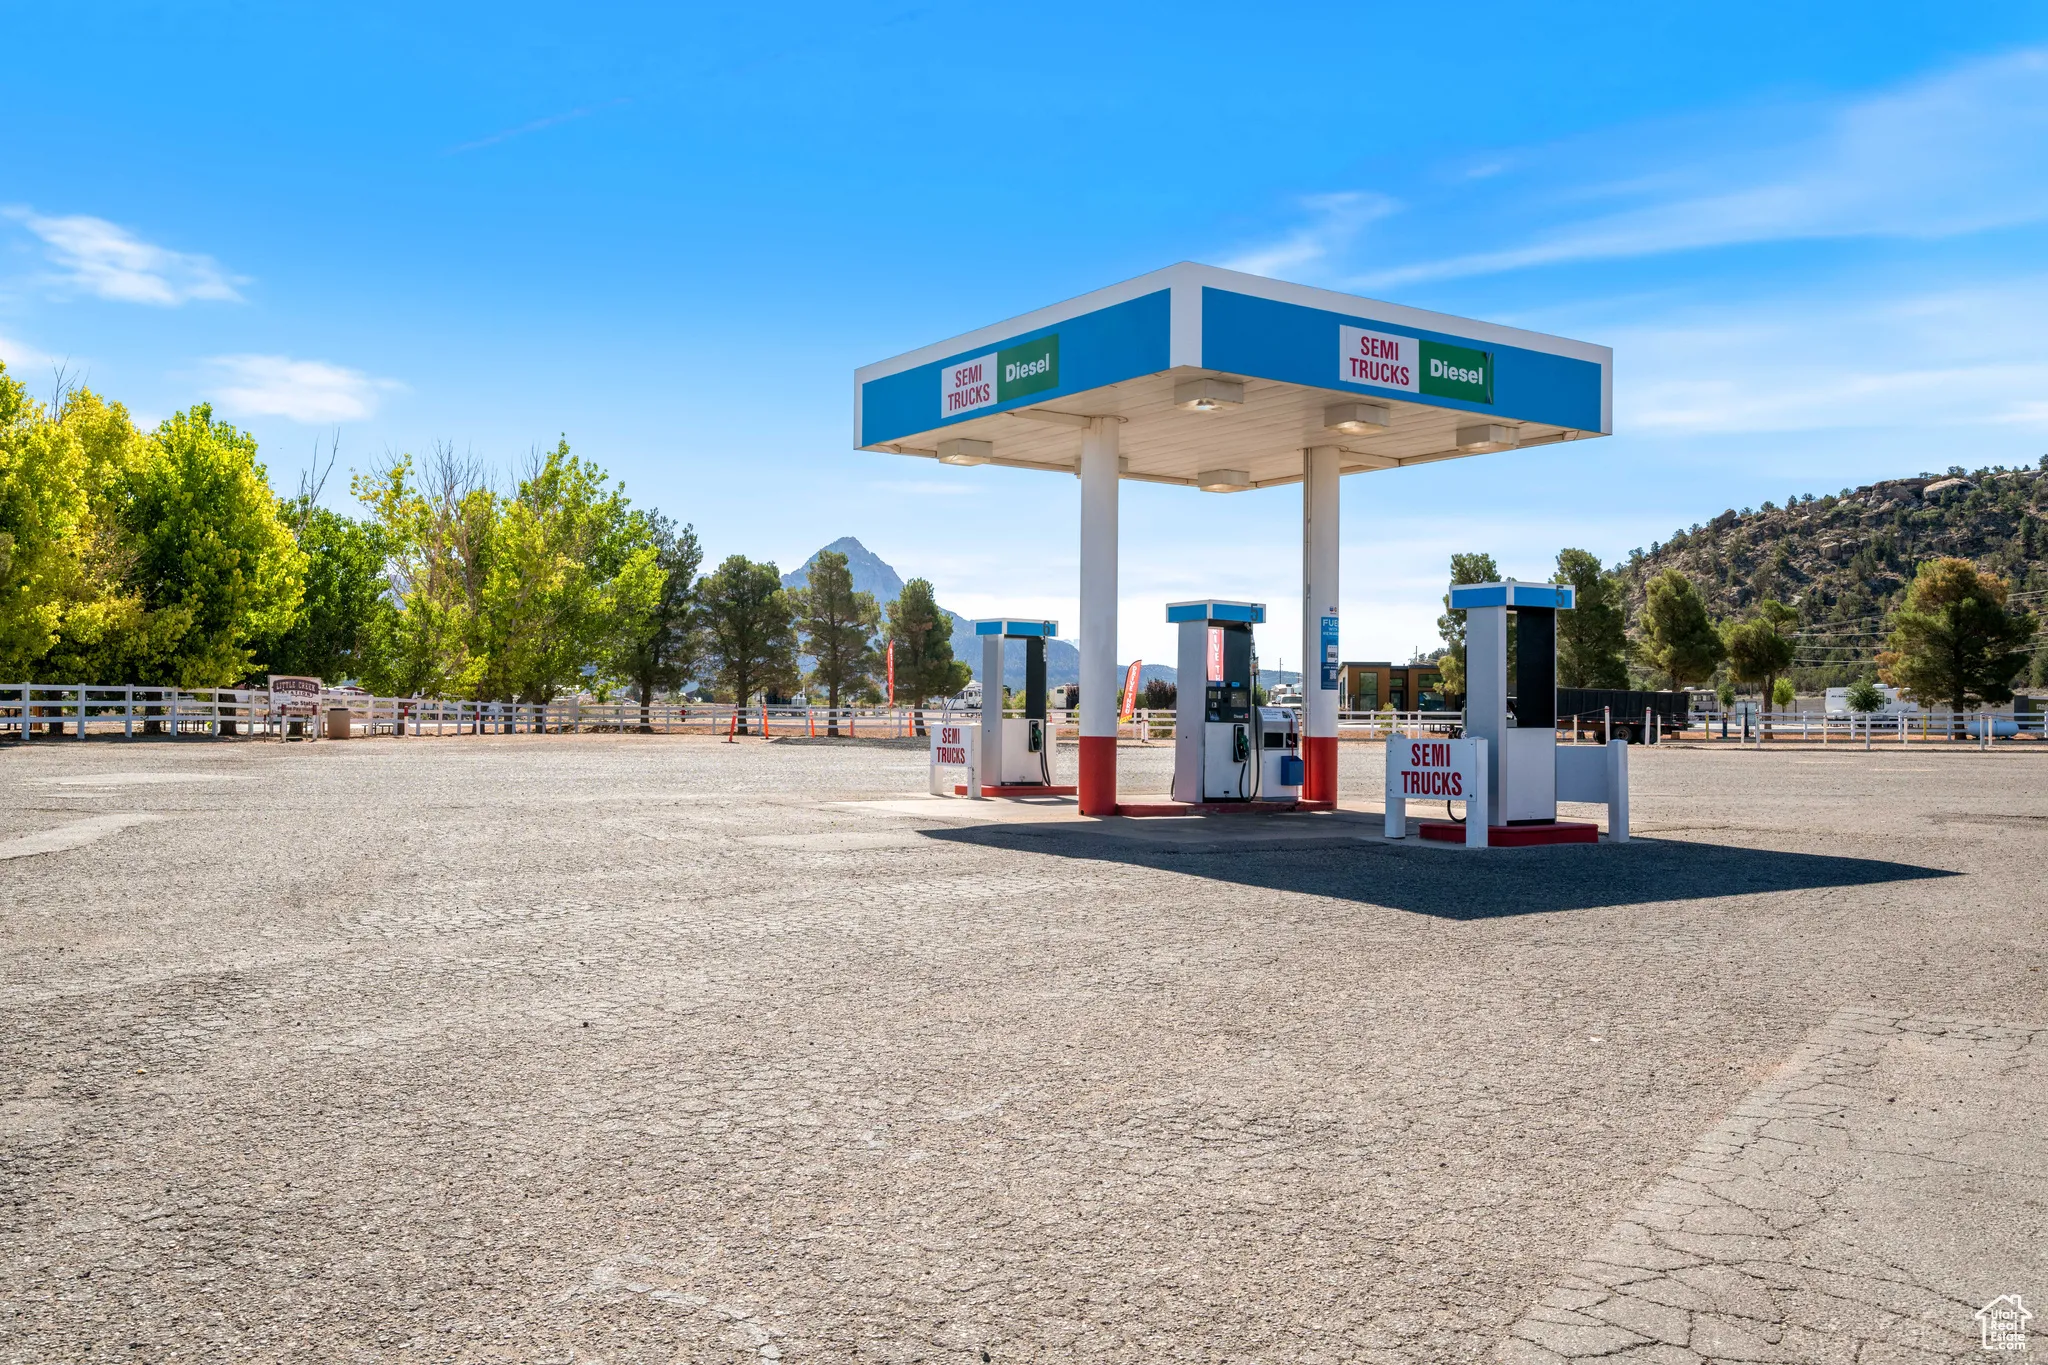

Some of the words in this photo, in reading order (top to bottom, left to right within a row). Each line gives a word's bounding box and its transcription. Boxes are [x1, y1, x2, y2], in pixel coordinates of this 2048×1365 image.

[1361, 336, 1399, 361] SEMI
[955, 364, 982, 388] SEMI
[1005, 353, 1050, 383] Diesel
[1350, 357, 1410, 386] TRUCKS
[1430, 358, 1484, 385] Diesel
[948, 383, 990, 411] TRUCKS
[1555, 585, 1565, 607] 5
[1250, 603, 1259, 622] 5
[1322, 618, 1338, 627] FUE
[1043, 620, 1050, 636] 6
[276, 681, 296, 690] LITTLE
[298, 681, 316, 692] CREEK
[1128, 665, 1138, 692] DRIVE
[1124, 692, 1133, 715] THRU
[942, 727, 960, 744] SEMI
[936, 746, 965, 764] TRUCKS
[1411, 743, 1451, 767] SEMI
[1401, 771, 1462, 796] TRUCKS
